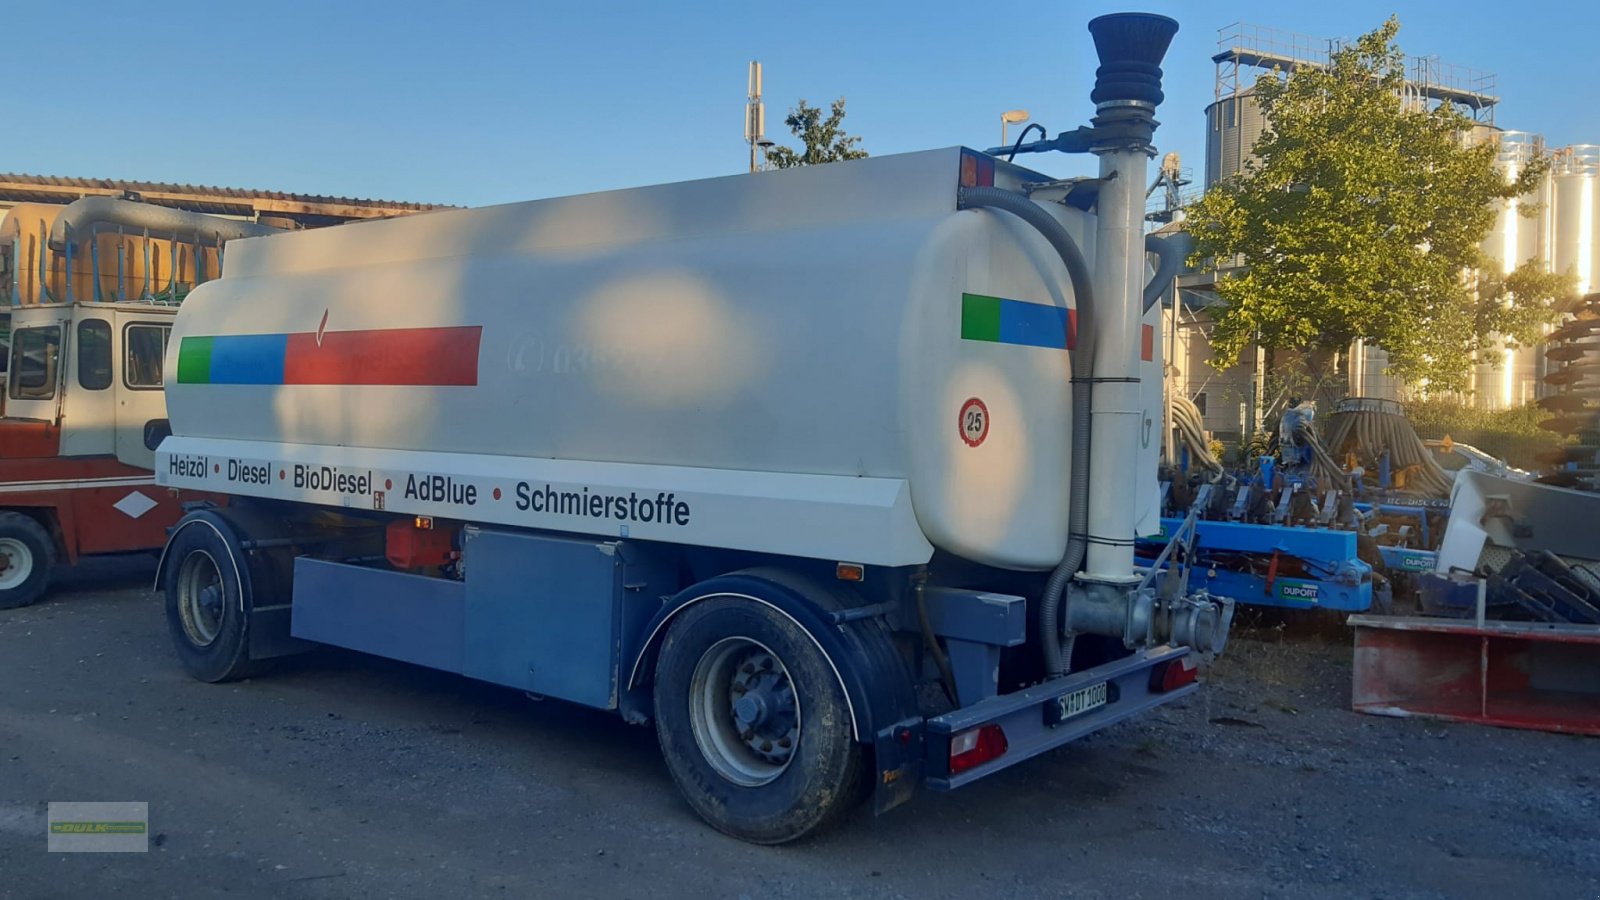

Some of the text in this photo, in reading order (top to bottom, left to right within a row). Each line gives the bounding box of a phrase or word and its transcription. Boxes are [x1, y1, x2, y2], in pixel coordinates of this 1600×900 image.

[967, 411, 982, 432] 25
[169, 453, 690, 526] Heizöl Diesel BioDiesel AdBlue Schmierstoffe
[1283, 586, 1317, 597] DUPORT
